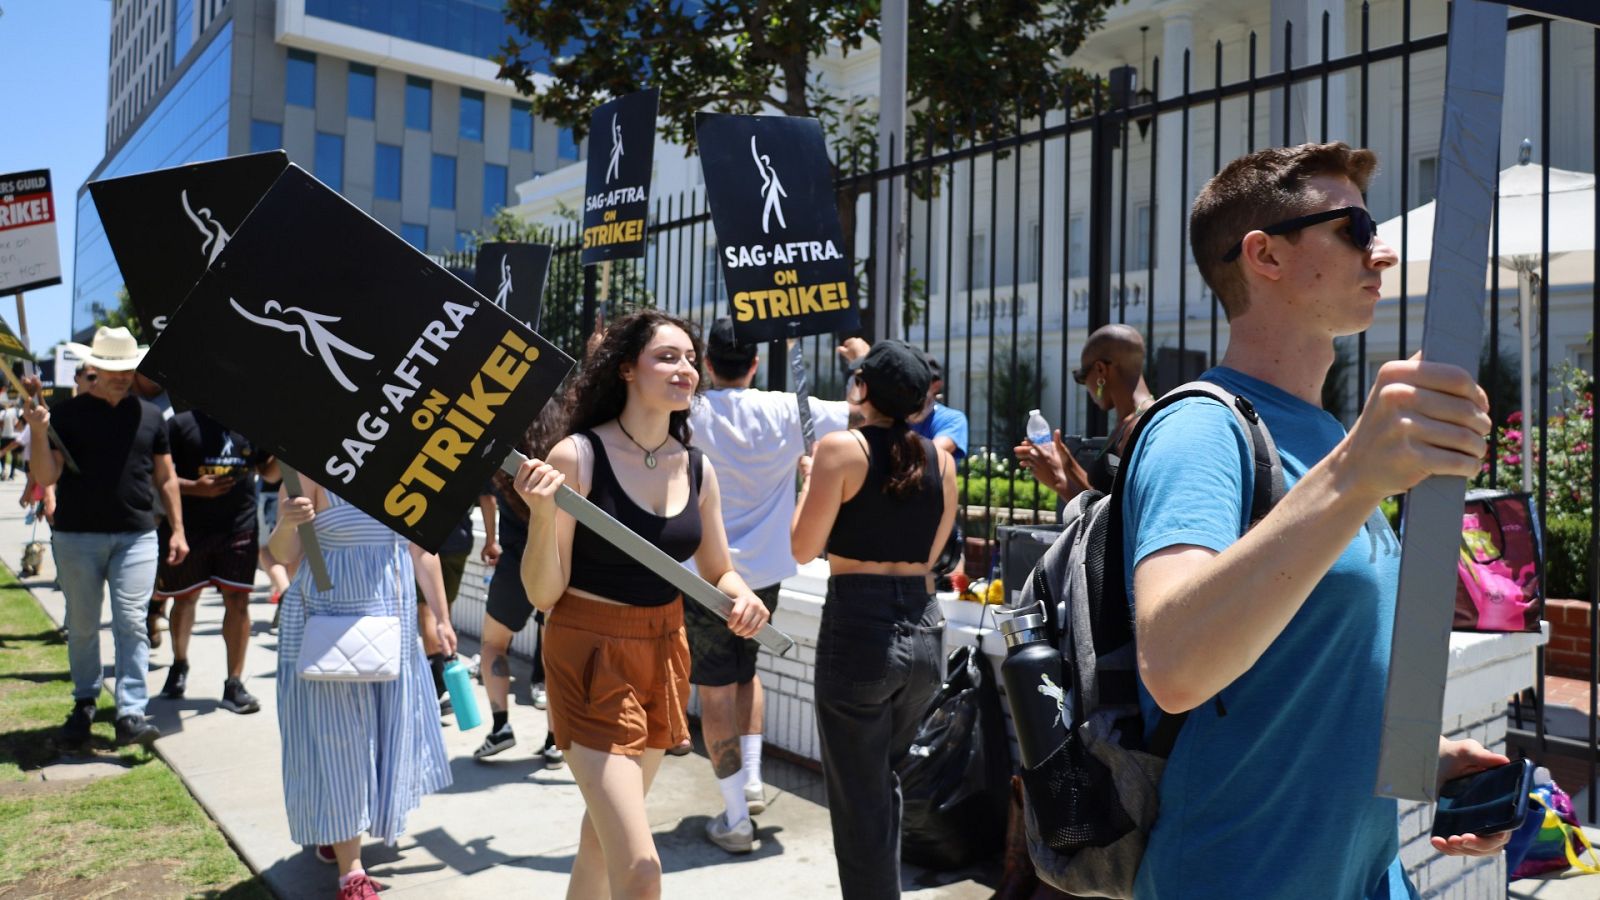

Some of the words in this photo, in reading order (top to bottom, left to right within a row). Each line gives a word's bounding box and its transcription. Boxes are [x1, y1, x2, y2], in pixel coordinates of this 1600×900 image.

[16, 177, 46, 191] GUILD
[603, 210, 616, 221] ON
[583, 219, 643, 249] STRIKE!
[774, 270, 797, 285] ON
[734, 282, 849, 321] STRIKE!
[411, 388, 450, 430] ON
[384, 329, 540, 527] STRIKE!
